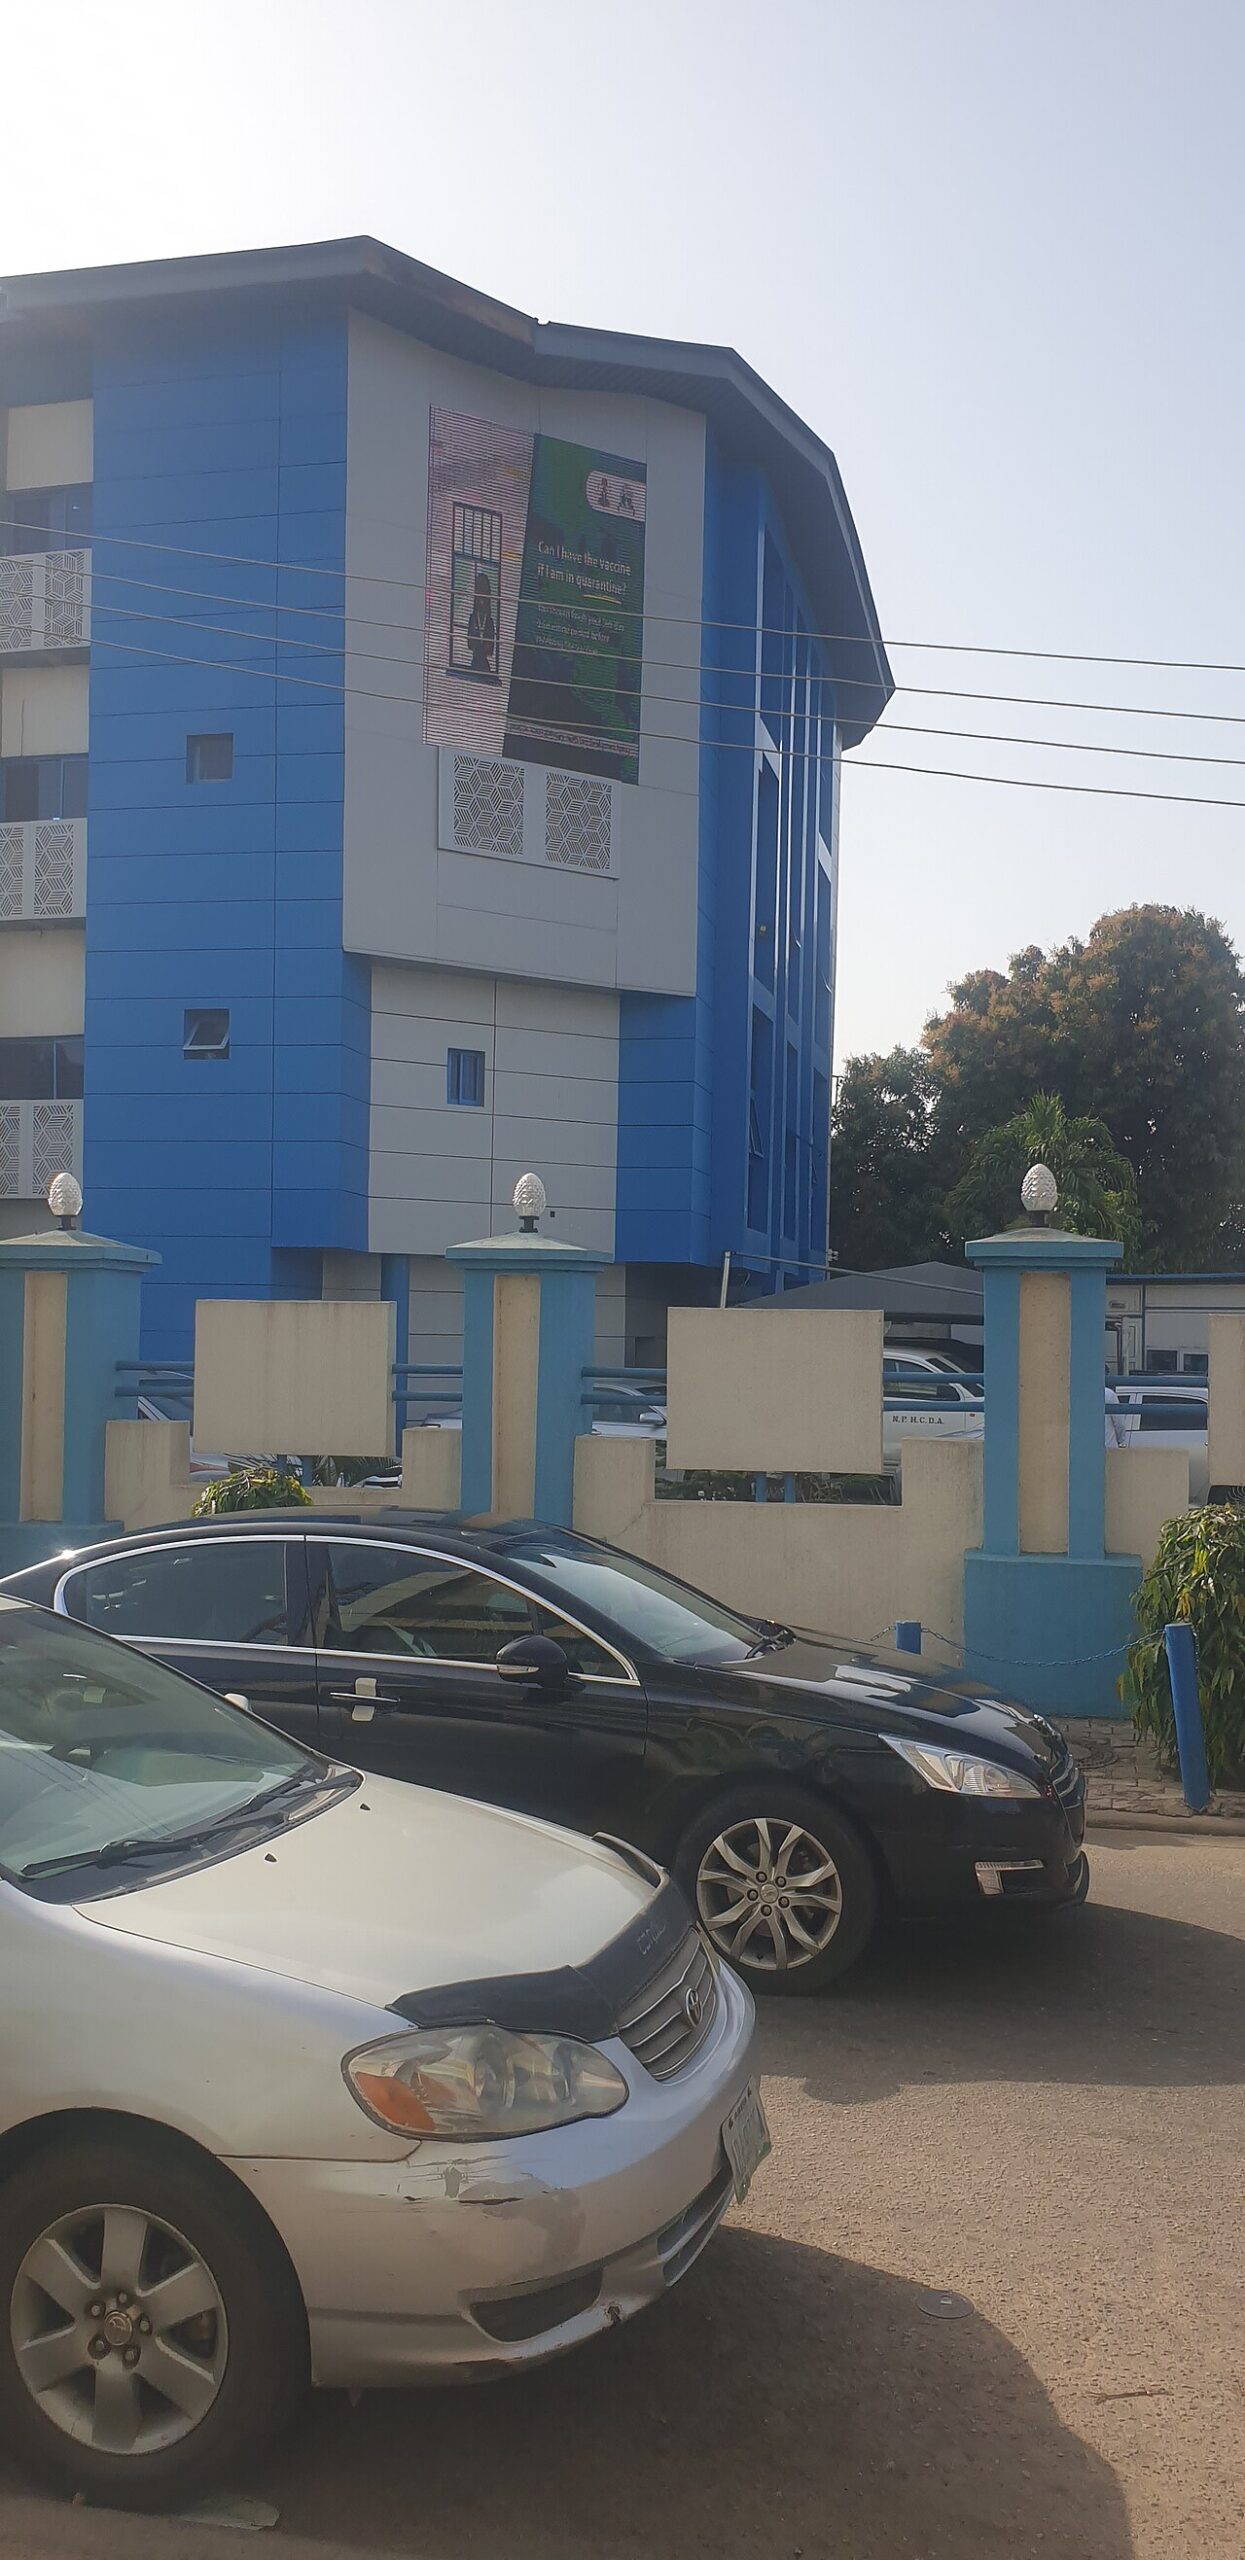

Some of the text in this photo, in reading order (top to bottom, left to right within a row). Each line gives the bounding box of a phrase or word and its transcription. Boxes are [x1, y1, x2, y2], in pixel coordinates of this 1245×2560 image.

[538, 541, 554, 555] Can
[561, 547, 582, 564] have
[584, 551, 598, 568] the
[600, 560, 632, 576] vaccine
[550, 568, 564, 581] am
